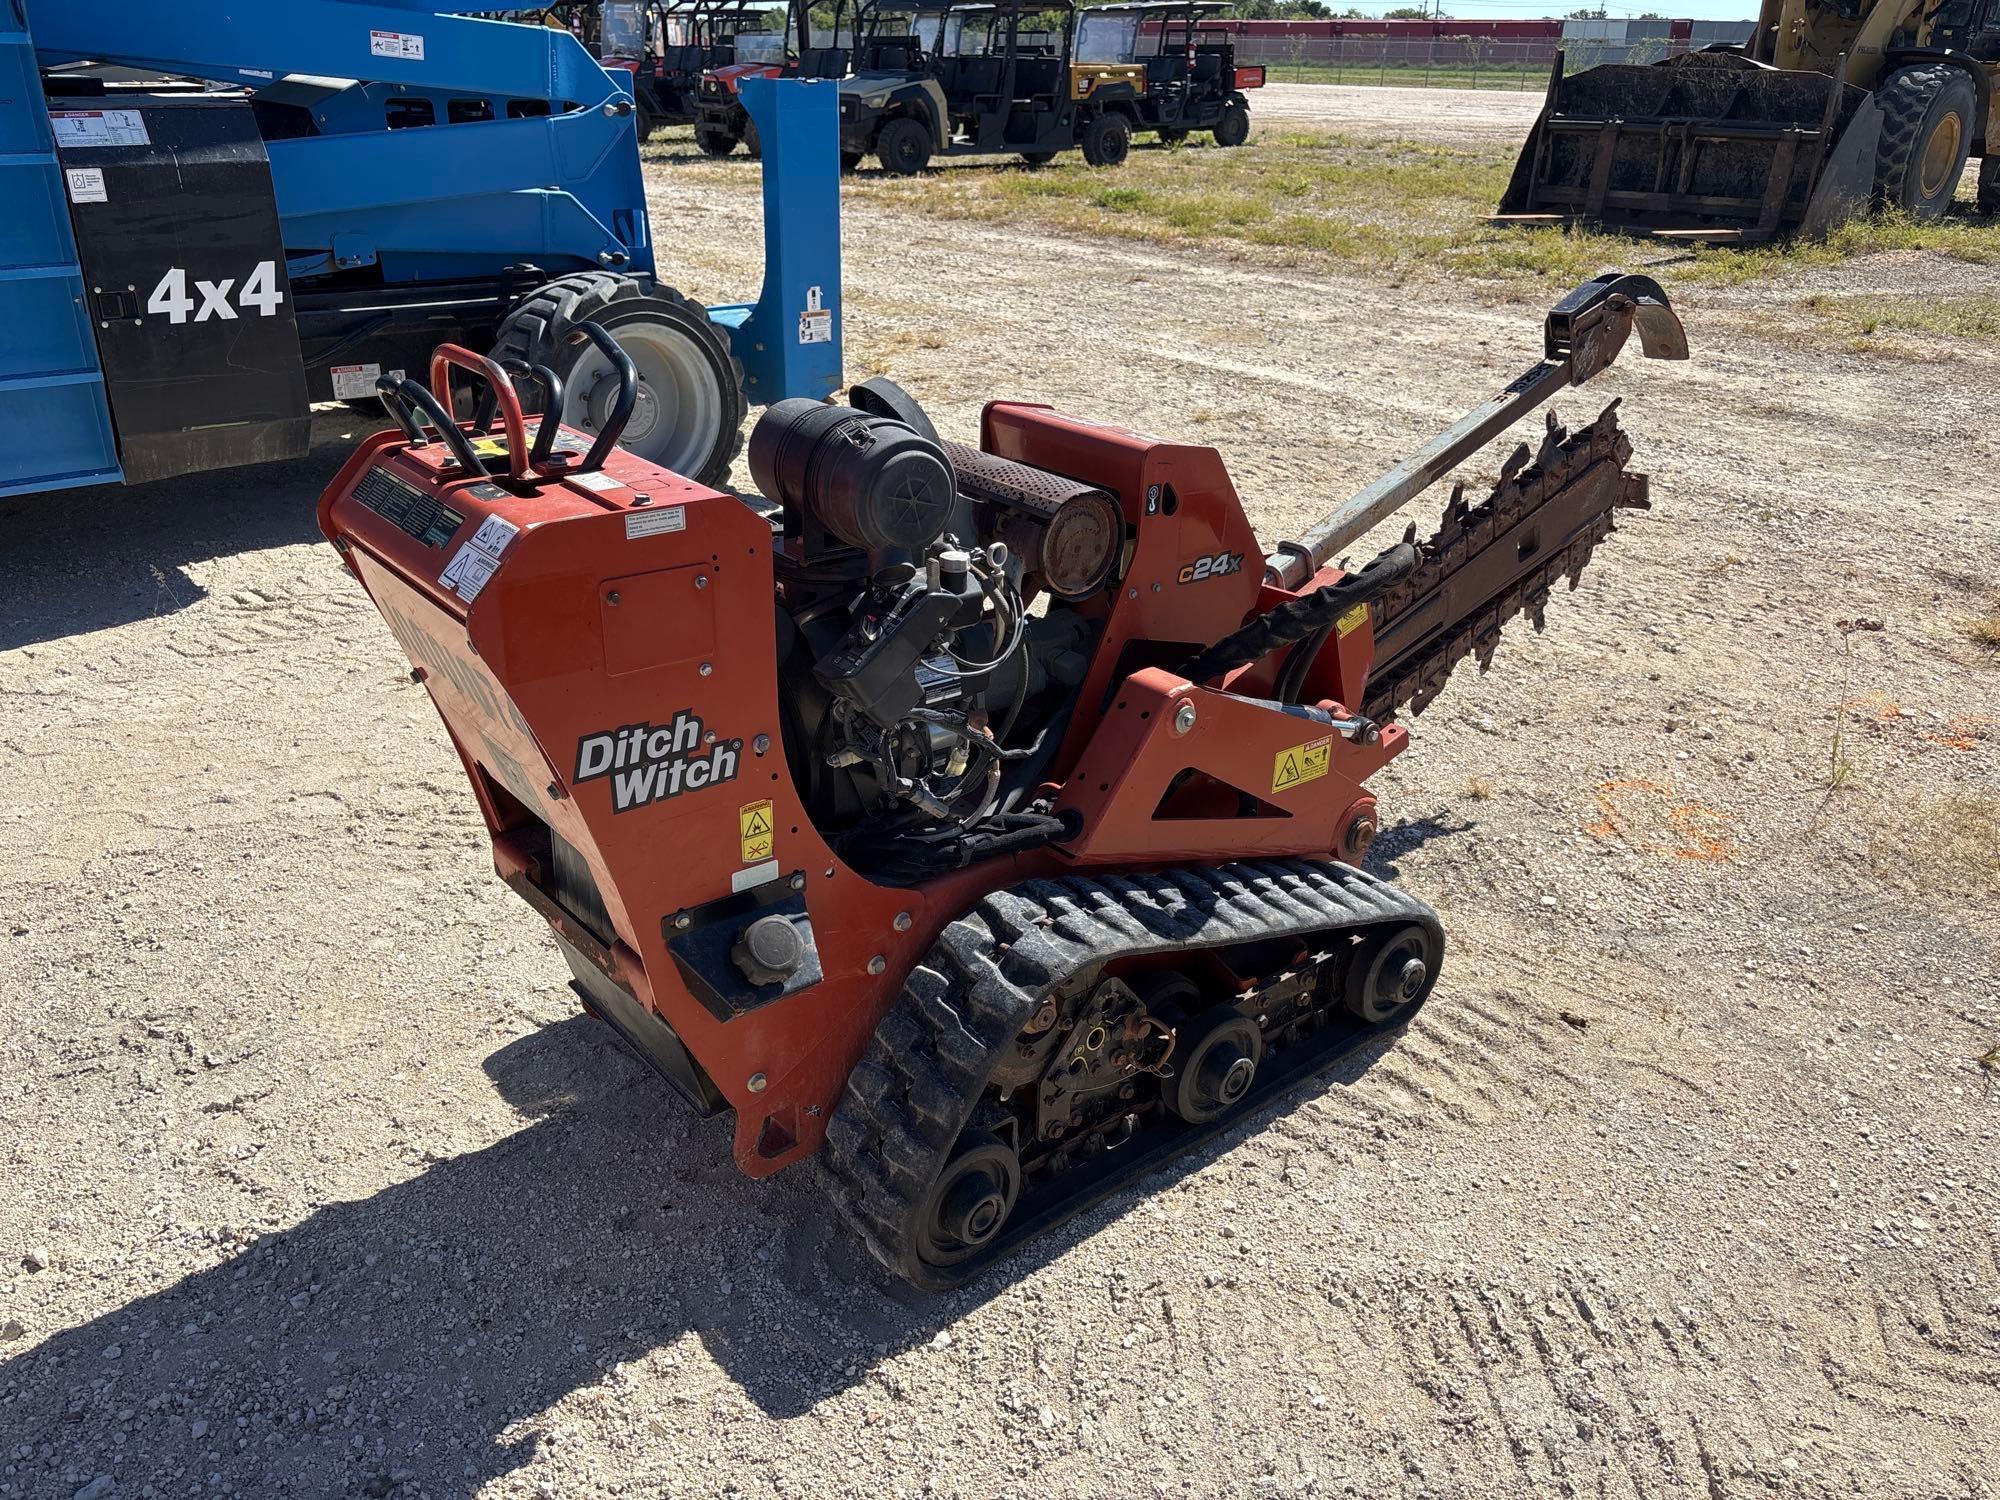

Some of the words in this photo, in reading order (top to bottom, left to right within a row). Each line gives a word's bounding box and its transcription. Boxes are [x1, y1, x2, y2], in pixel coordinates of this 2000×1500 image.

[147, 261, 283, 324] 4x4
[578, 715, 700, 779] Ditch
[614, 746, 736, 809] Witch
